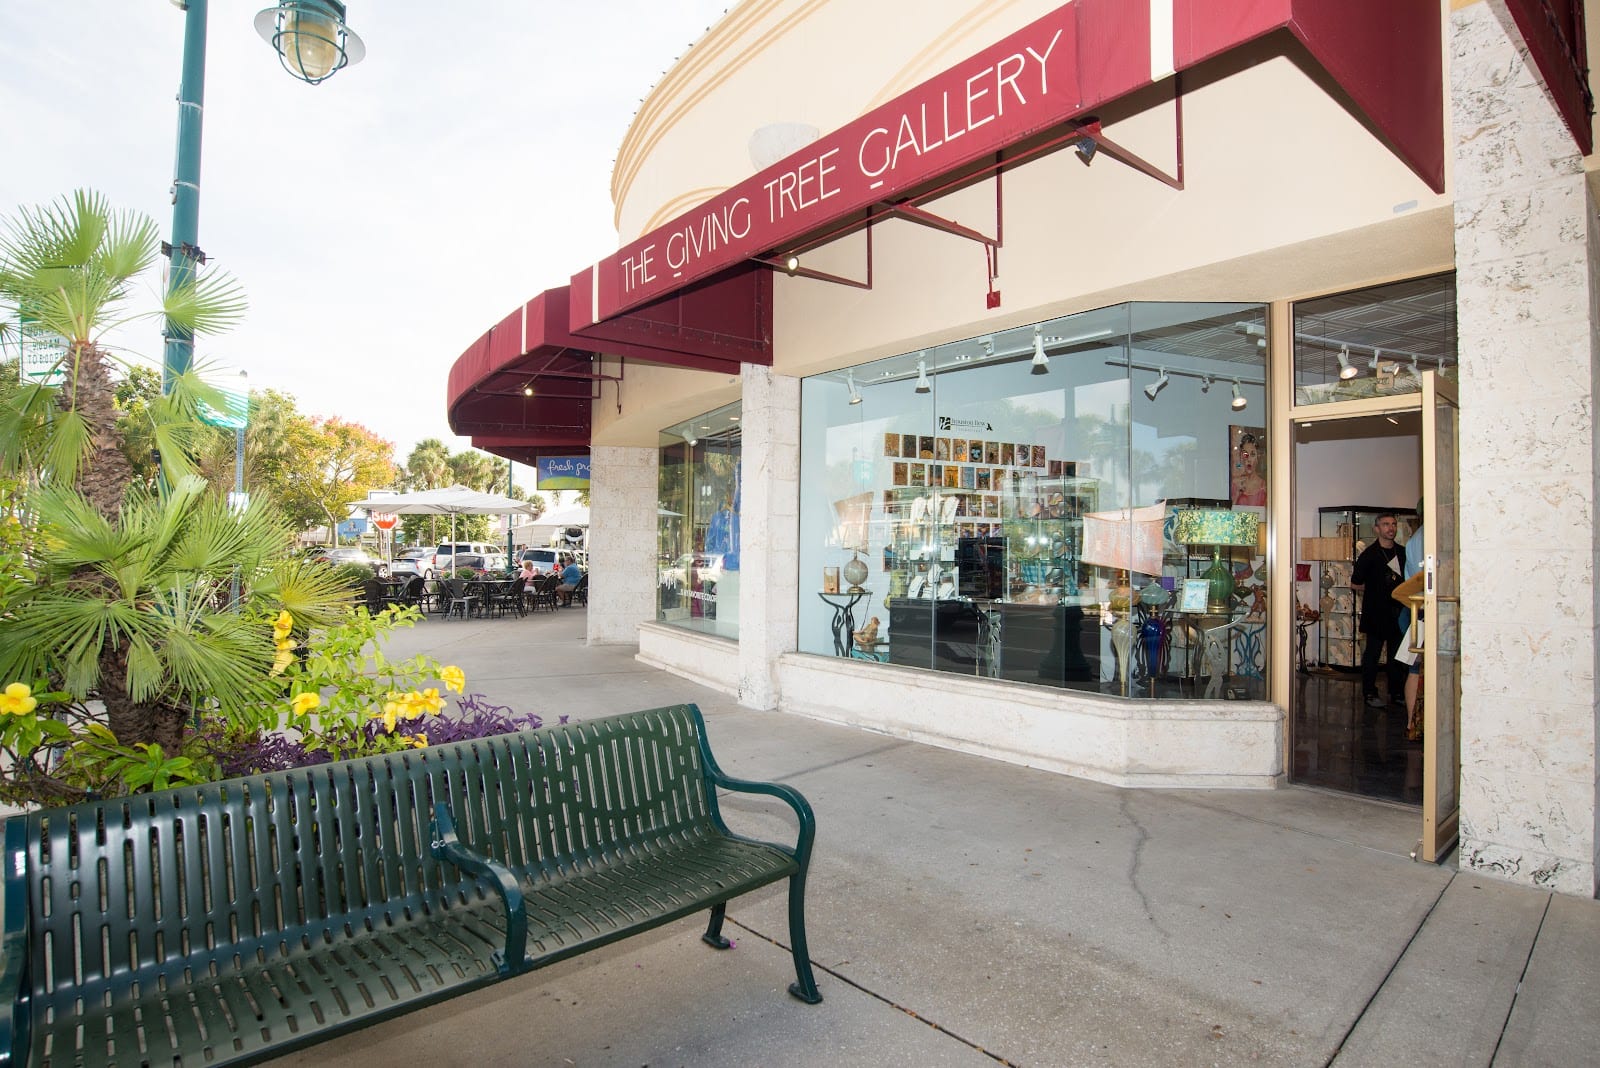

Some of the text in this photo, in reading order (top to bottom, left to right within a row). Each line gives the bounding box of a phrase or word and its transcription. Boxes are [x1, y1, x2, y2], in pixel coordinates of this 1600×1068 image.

[621, 28, 1063, 294] THE GIVING TREE GALLERY
[546, 459, 573, 476] fresh
